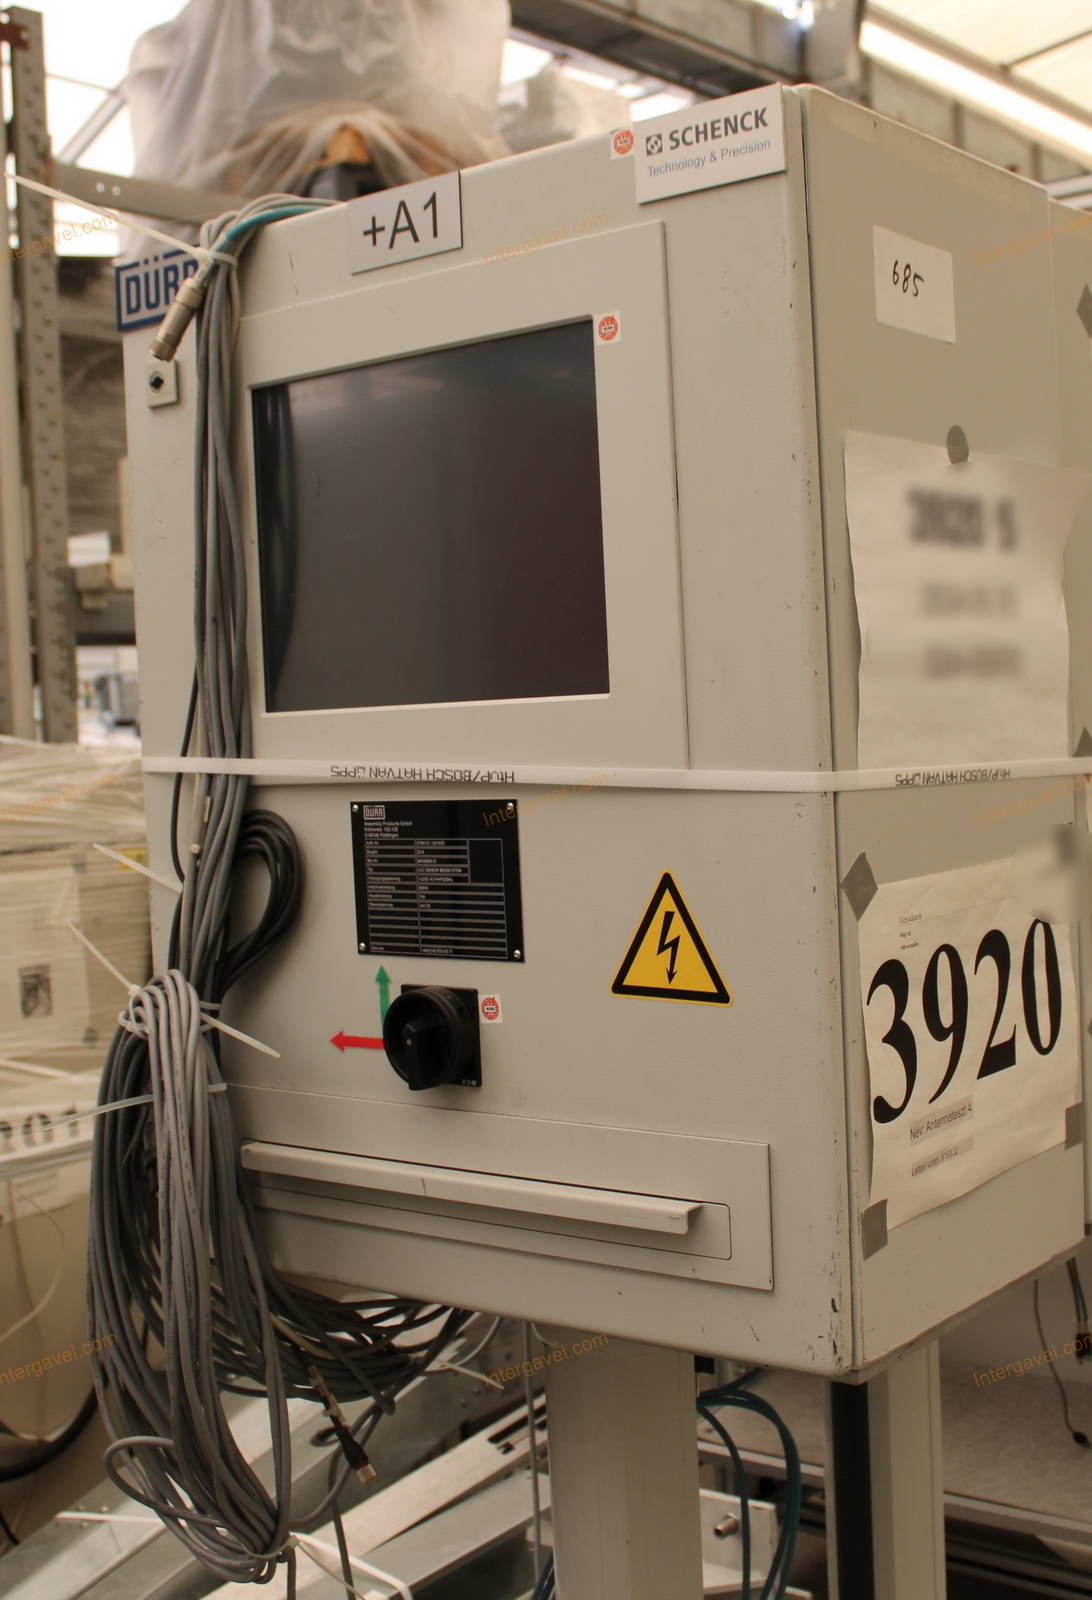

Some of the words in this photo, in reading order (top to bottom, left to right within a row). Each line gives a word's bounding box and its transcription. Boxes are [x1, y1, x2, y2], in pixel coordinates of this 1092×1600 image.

[668, 107, 769, 150] SCHENCK
[648, 155, 706, 178] Technology
[709, 150, 718, 163] &
[720, 138, 771, 161] Precision
[362, 191, 438, 249] +A1
[892, 259, 925, 297] 685
[369, 765, 422, 780] HATVAN
[866, 918, 1062, 1125] 3920
